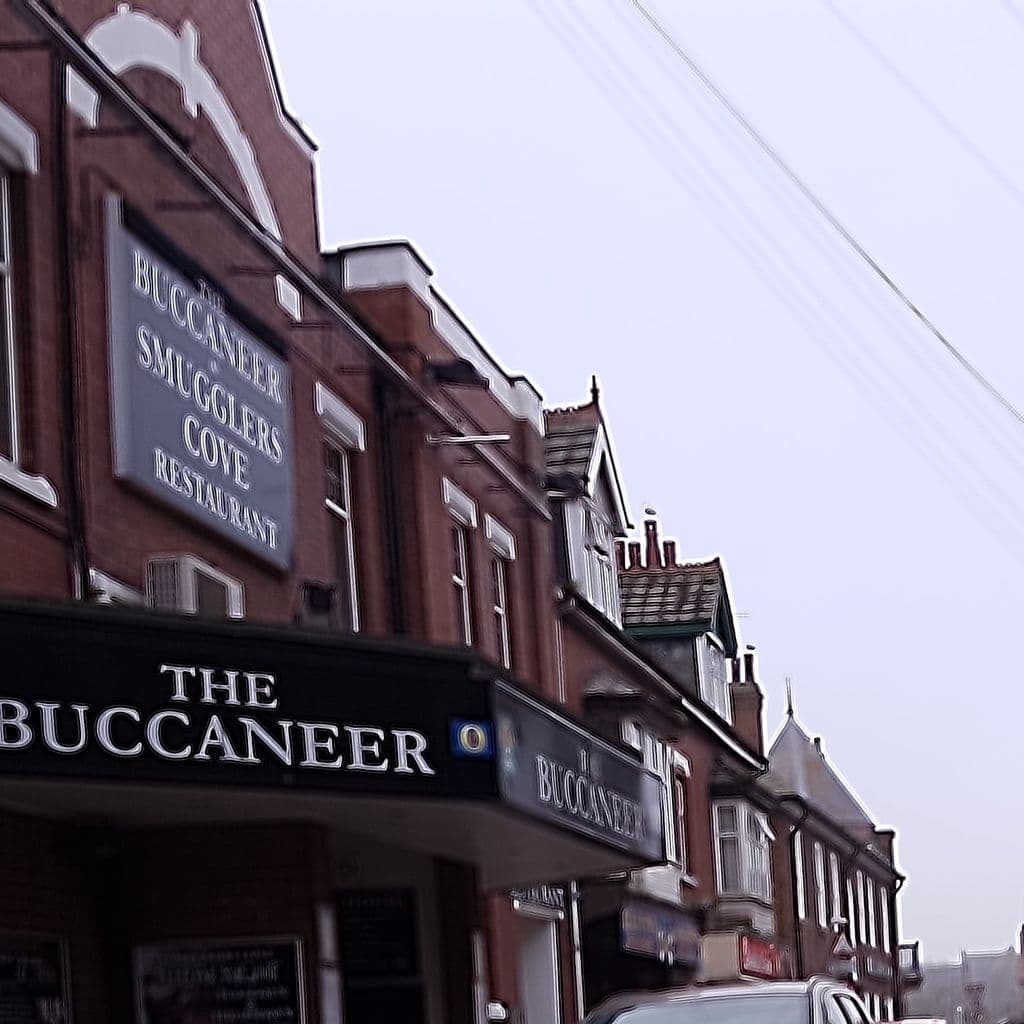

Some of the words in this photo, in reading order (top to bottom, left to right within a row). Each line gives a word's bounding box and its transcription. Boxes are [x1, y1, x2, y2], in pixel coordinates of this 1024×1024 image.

[133, 248, 282, 404] BUCCANEER
[136, 325, 284, 464] SMUGGLERS
[183, 414, 250, 491] COVE
[154, 447, 279, 550] RESTAURANT
[160, 664, 279, 708] THE
[0, 699, 436, 775] BUCCANEER
[535, 754, 647, 839] BUCCANEER
